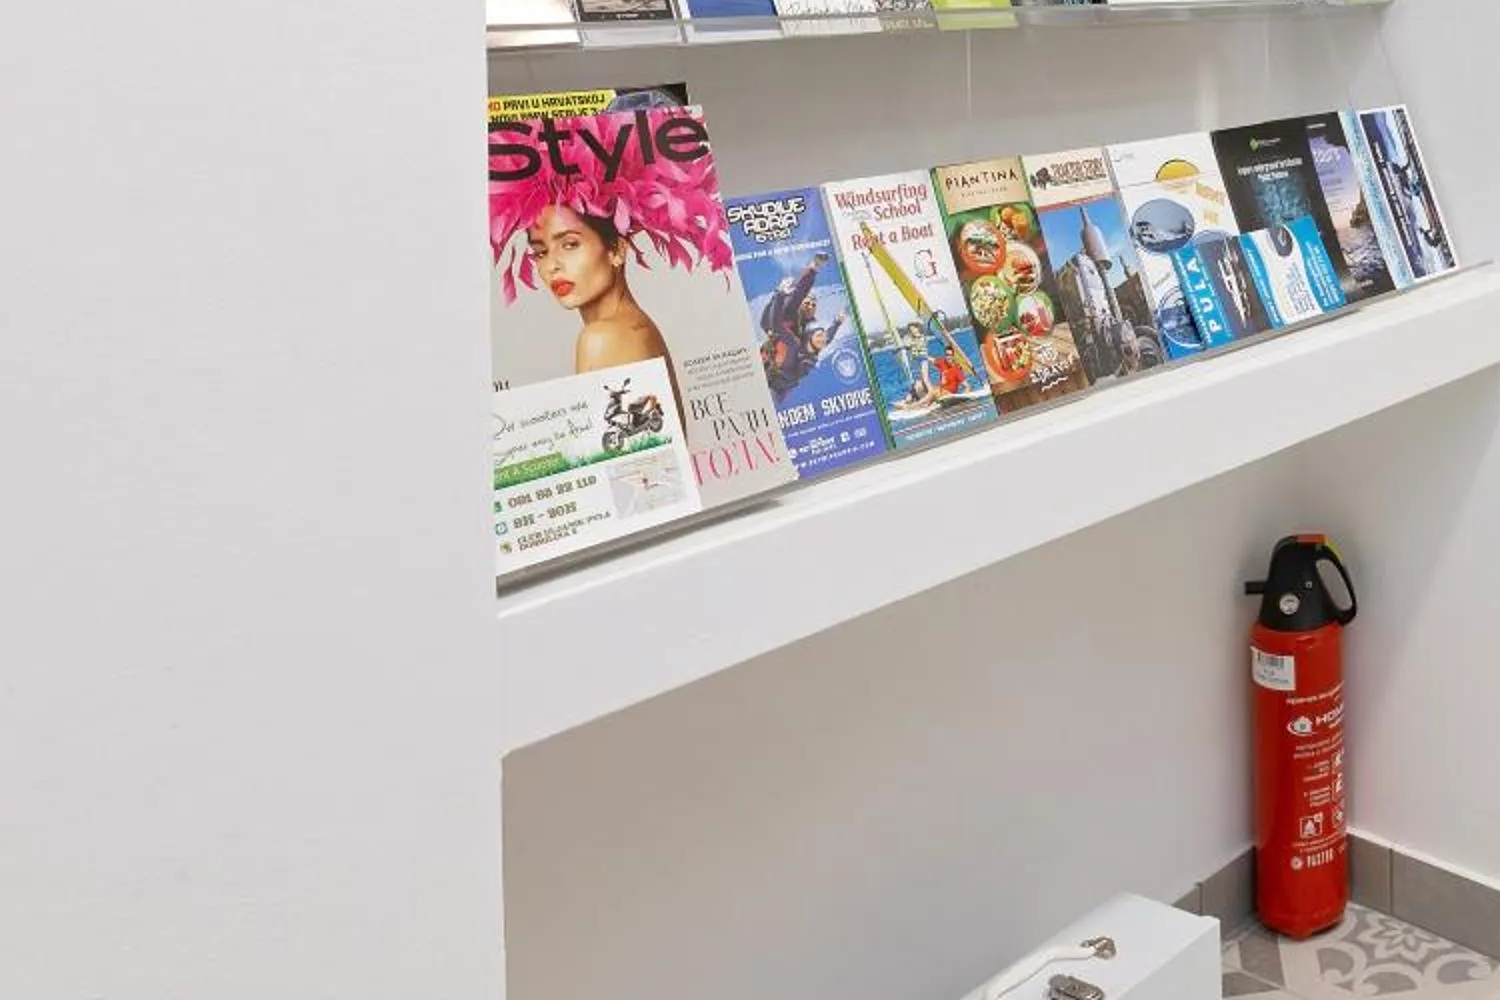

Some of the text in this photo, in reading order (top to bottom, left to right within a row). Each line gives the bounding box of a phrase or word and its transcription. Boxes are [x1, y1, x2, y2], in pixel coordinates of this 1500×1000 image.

[542, 93, 605, 108] HRVATSKOJ
[488, 109, 709, 182] Style
[945, 167, 1020, 192] PIANTINA
[834, 182, 928, 210] Windsurfing
[873, 198, 924, 221] School
[900, 223, 935, 242] Boat
[1186, 256, 1223, 333] PULA
[820, 387, 874, 417] SKYDIVE
